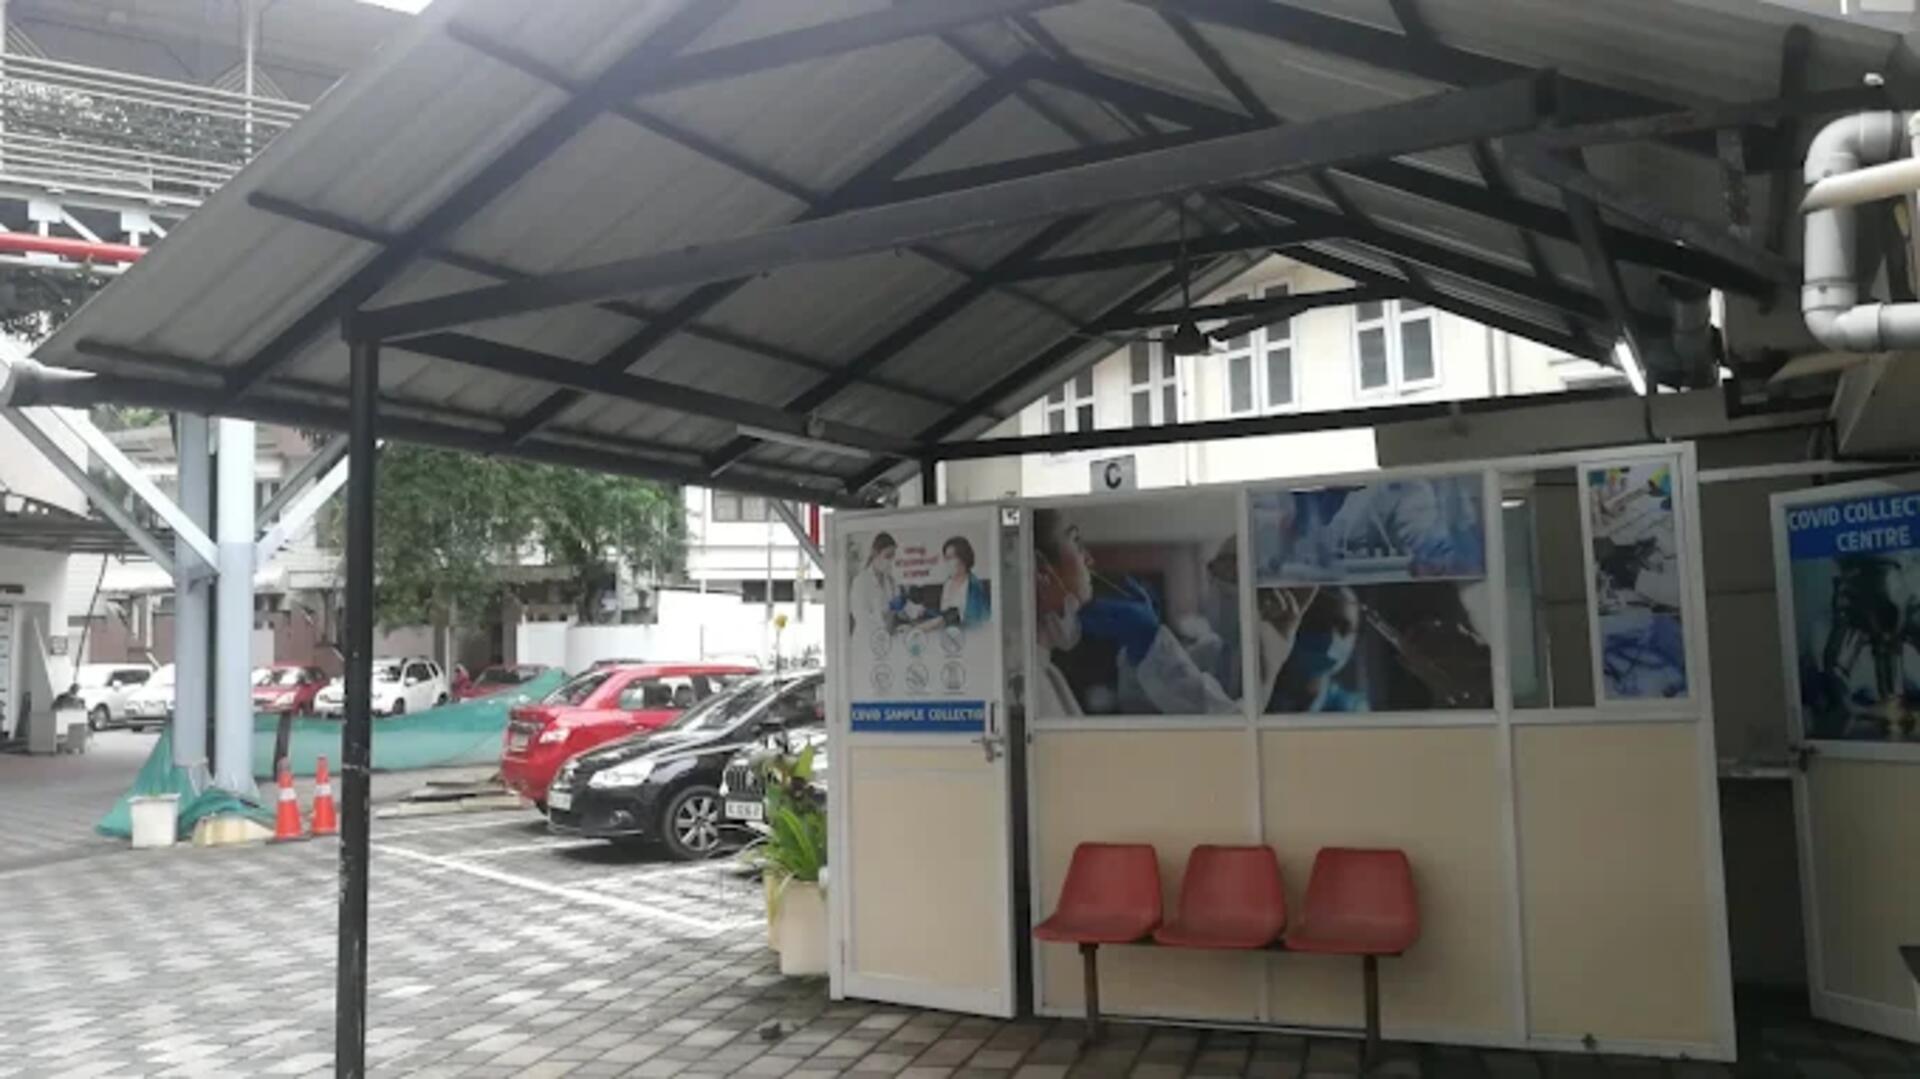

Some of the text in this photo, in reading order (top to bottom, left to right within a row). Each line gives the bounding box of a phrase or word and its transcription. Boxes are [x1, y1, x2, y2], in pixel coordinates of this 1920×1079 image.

[1104, 462, 1122, 489] C
[1789, 505, 1840, 531] COVID
[1836, 525, 1911, 552] CENTRE
[851, 707, 881, 721] COVID
[884, 707, 924, 721] SAMPLE
